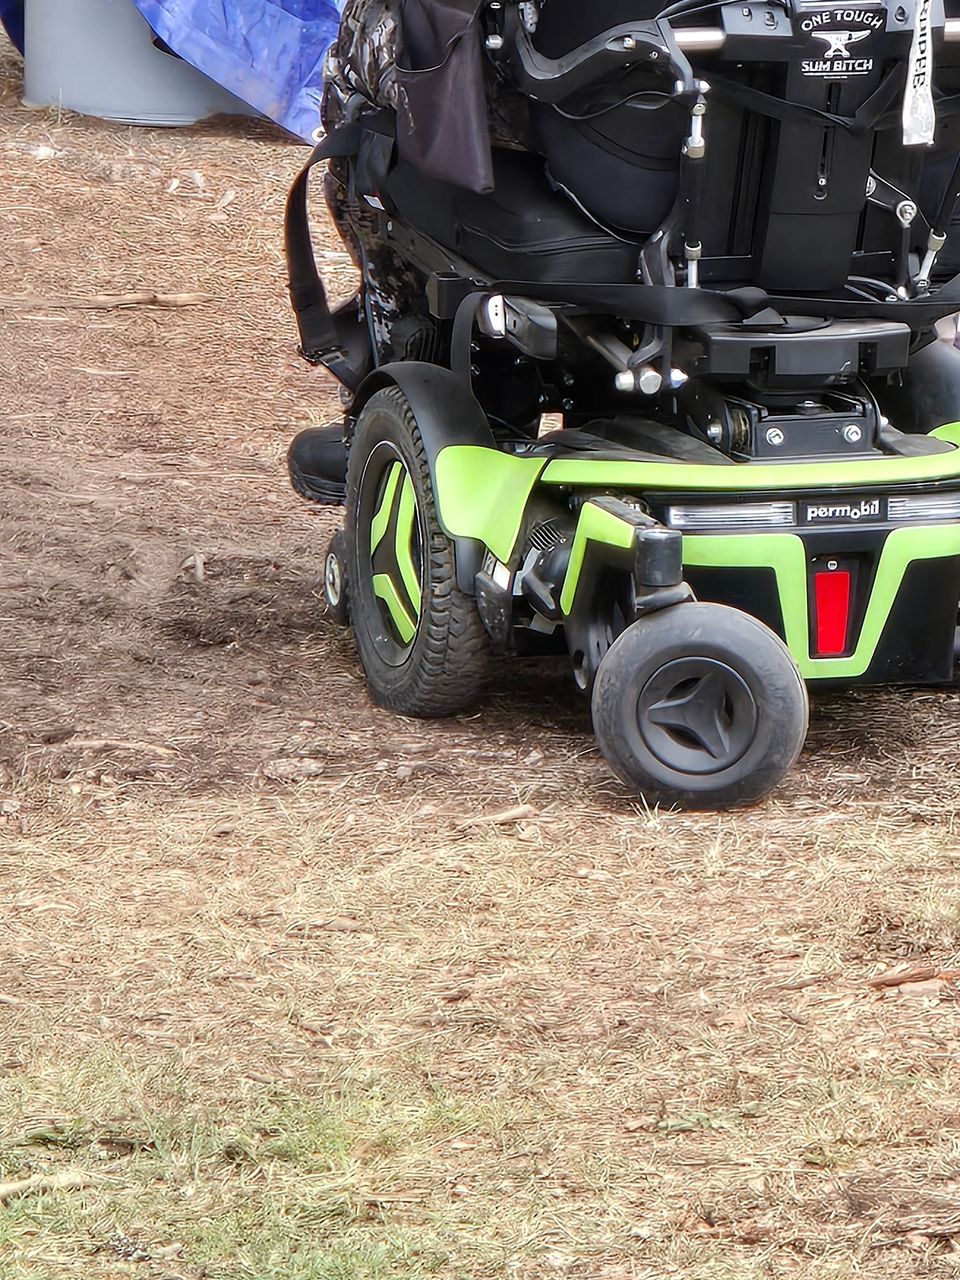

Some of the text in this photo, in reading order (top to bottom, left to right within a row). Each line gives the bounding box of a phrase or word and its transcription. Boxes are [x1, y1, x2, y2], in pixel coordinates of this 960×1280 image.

[801, 9, 884, 31] ONE TOUGH
[801, 58, 873, 72] SUM BITCH
[806, 498, 880, 521] permobil
